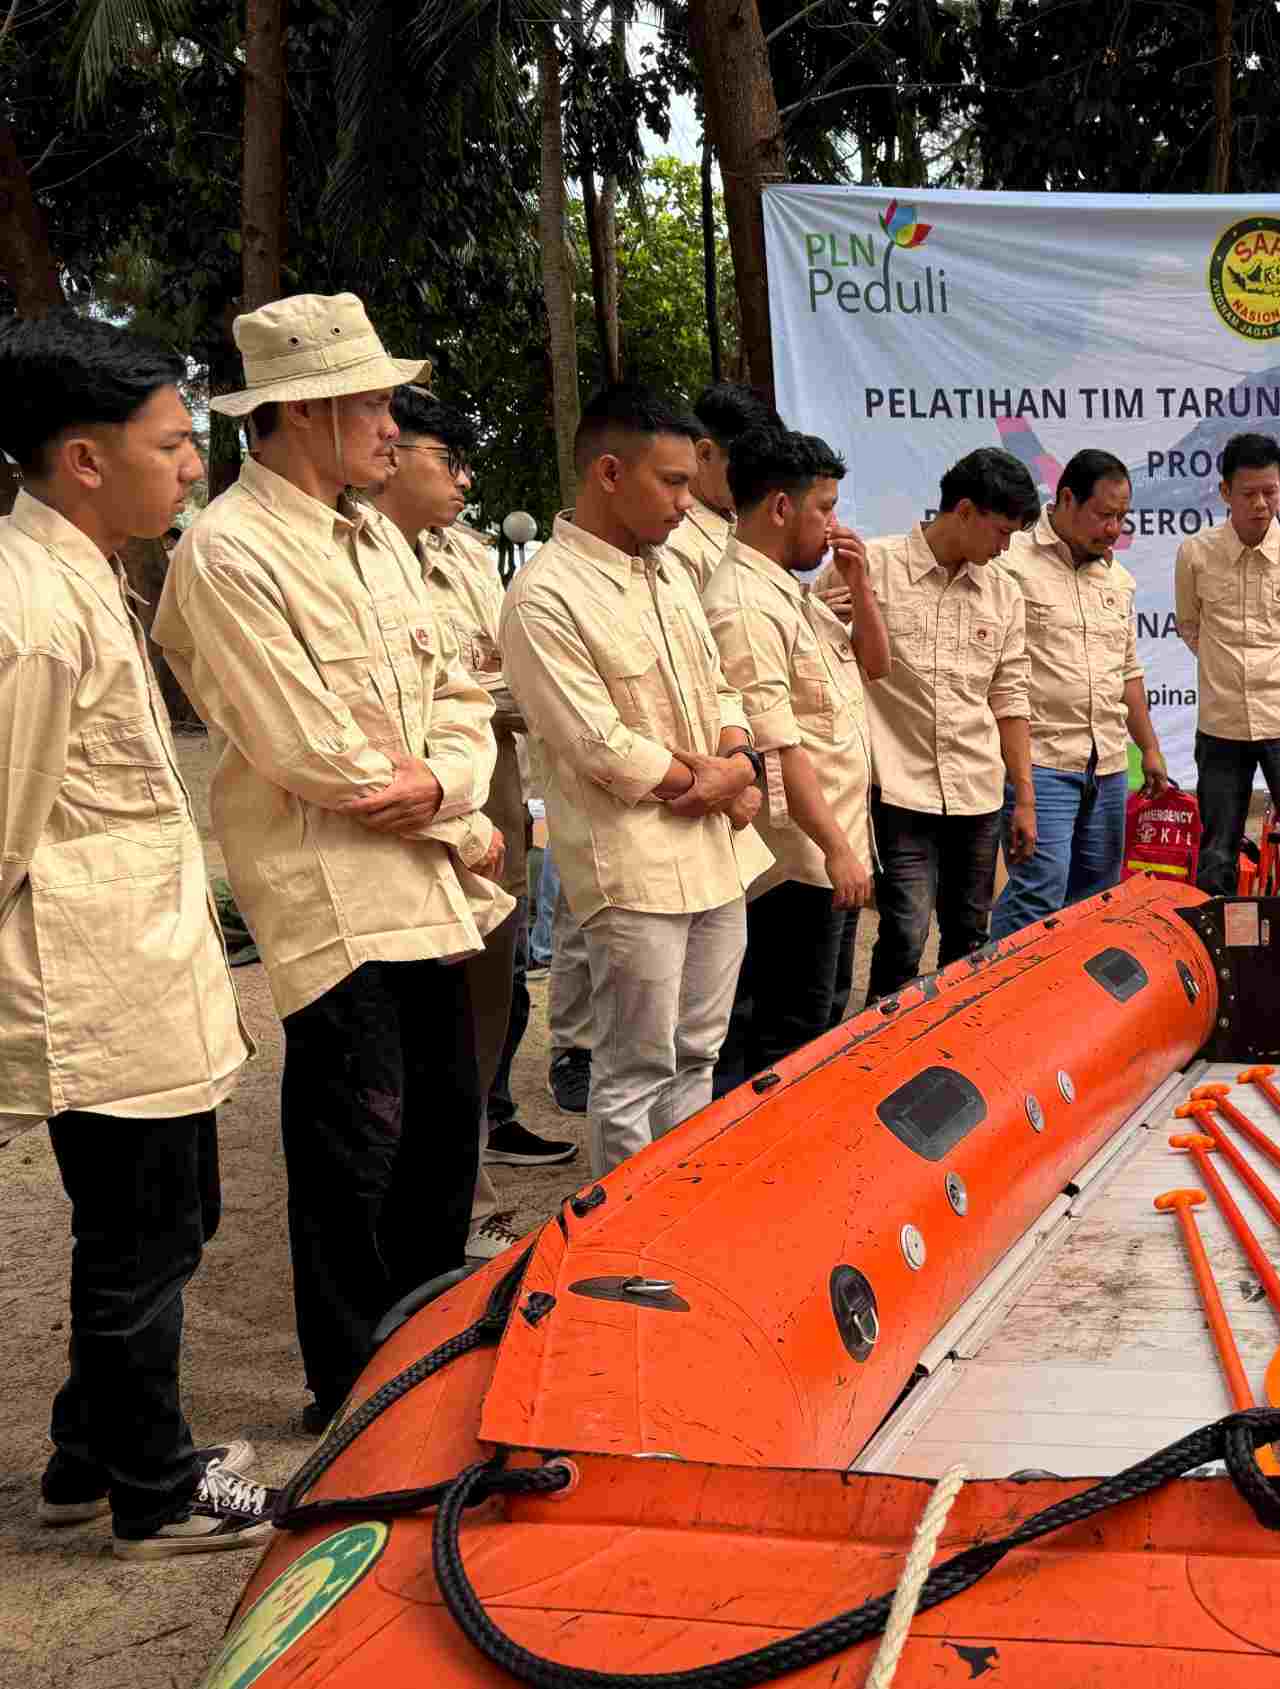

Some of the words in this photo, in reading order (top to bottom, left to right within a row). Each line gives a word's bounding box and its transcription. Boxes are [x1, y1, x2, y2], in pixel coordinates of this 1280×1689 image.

[806, 232, 876, 268] PLN
[808, 262, 949, 315] Peduli
[865, 388, 1077, 418] PELATIHAN
[1080, 388, 1143, 418] TIM
[1139, 809, 1194, 824] EMERGENCY
